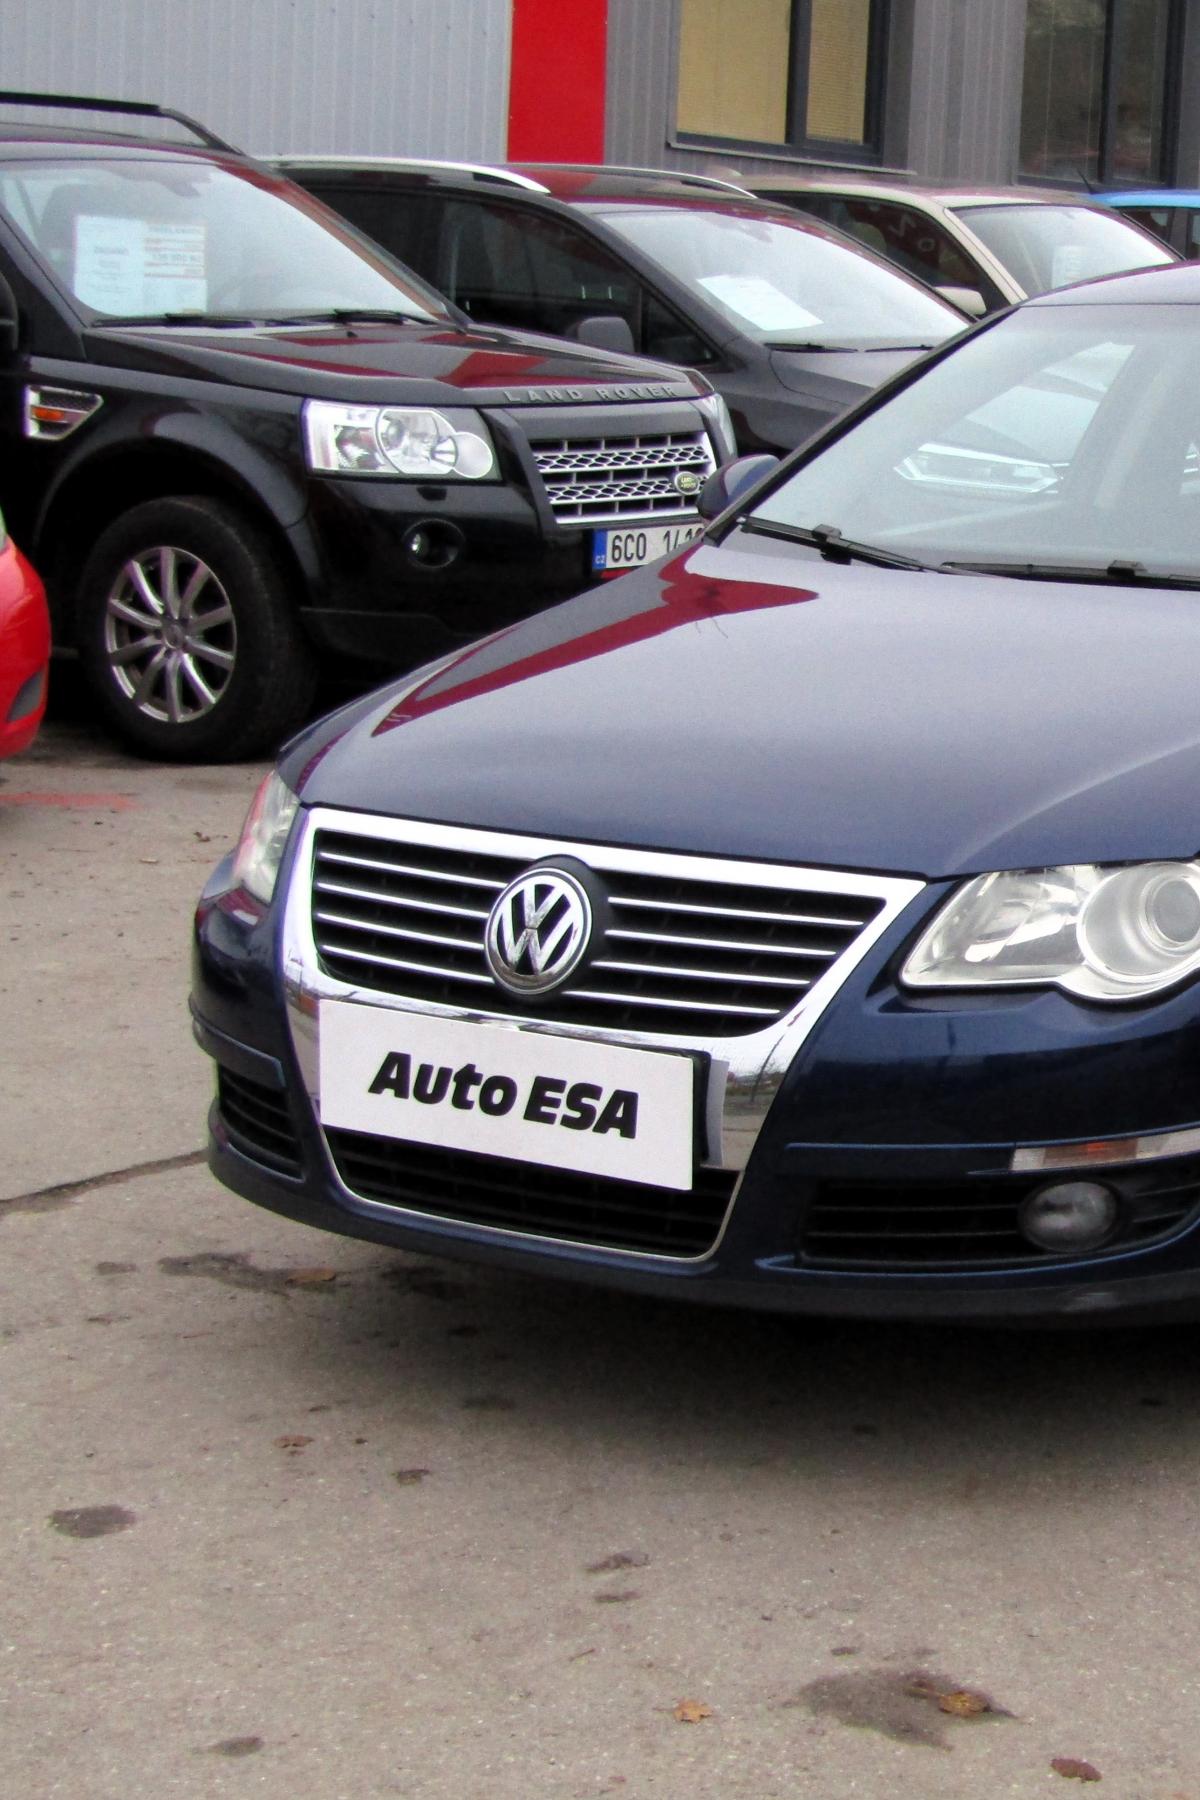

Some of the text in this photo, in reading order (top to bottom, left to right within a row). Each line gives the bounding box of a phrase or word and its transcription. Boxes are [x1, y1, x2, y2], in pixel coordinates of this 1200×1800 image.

[503, 385, 678, 402] LAND ROVER
[367, 1051, 640, 1140] Auto ESA
